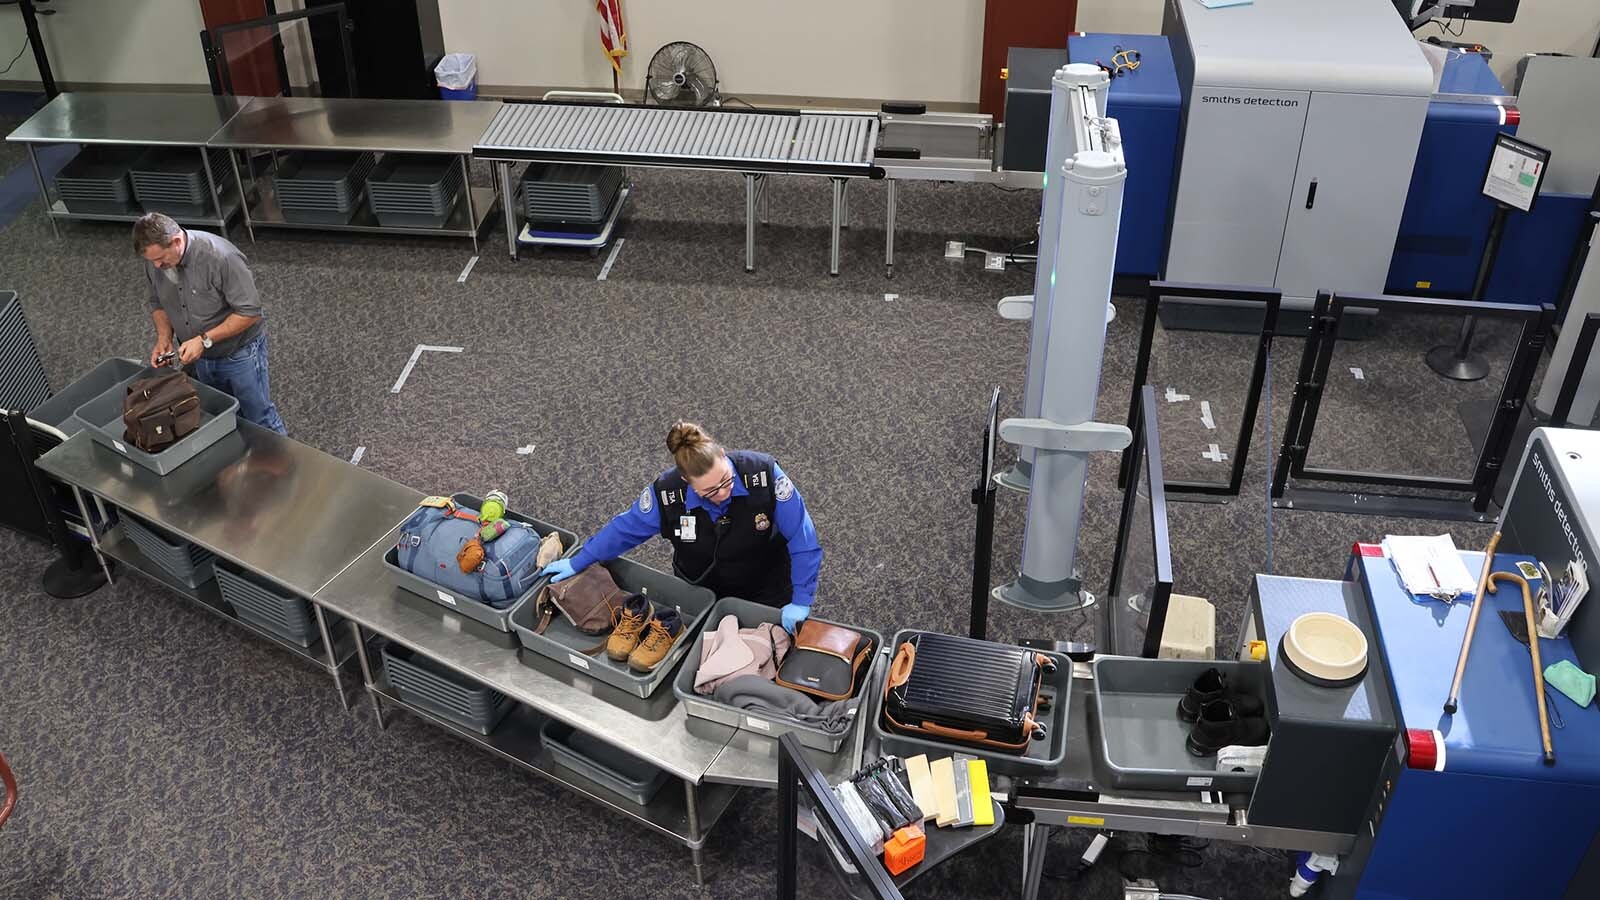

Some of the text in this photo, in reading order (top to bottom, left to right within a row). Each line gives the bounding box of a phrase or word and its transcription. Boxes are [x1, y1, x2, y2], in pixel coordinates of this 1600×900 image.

[1202, 95, 1299, 107] smiths detection
[752, 472, 760, 487] TSA
[1532, 453, 1556, 503] smiths
